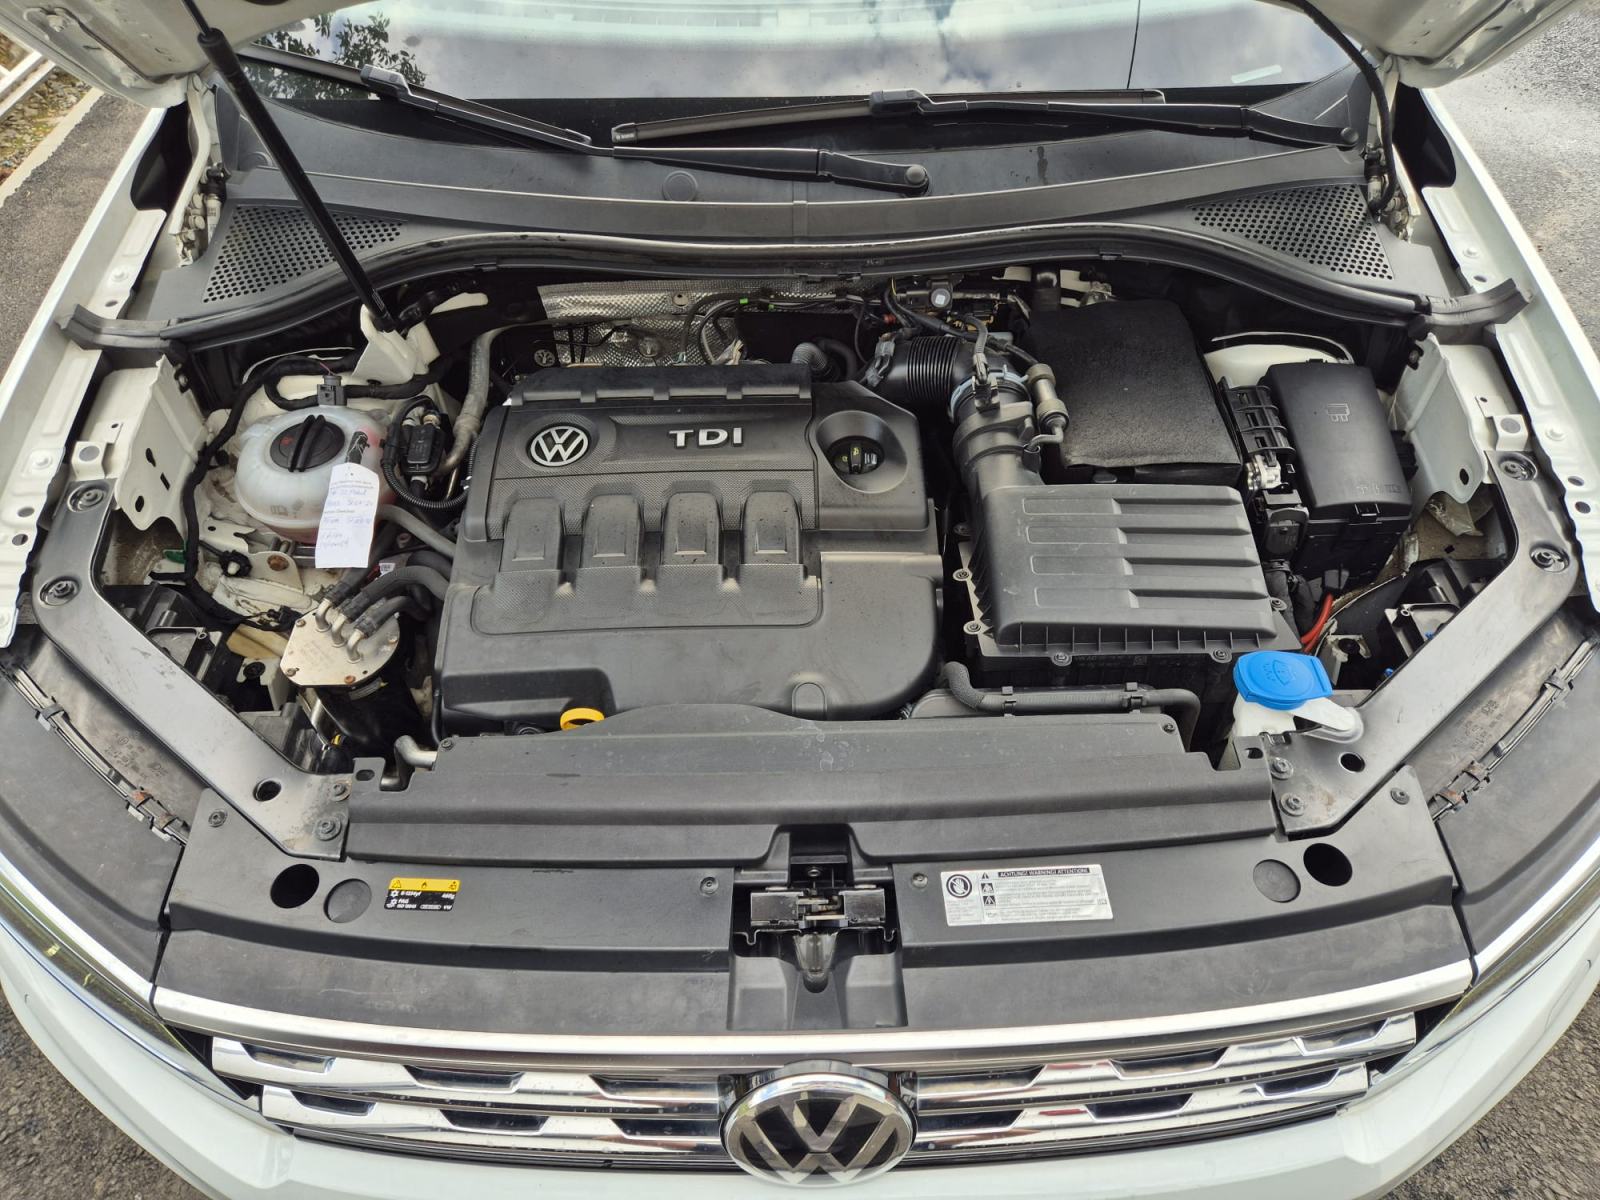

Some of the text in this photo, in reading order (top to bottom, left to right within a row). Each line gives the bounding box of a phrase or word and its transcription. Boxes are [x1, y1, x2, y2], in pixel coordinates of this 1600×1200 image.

[531, 426, 588, 466] VW
[668, 427, 743, 447] TDI
[728, 1083, 910, 1186] VW
